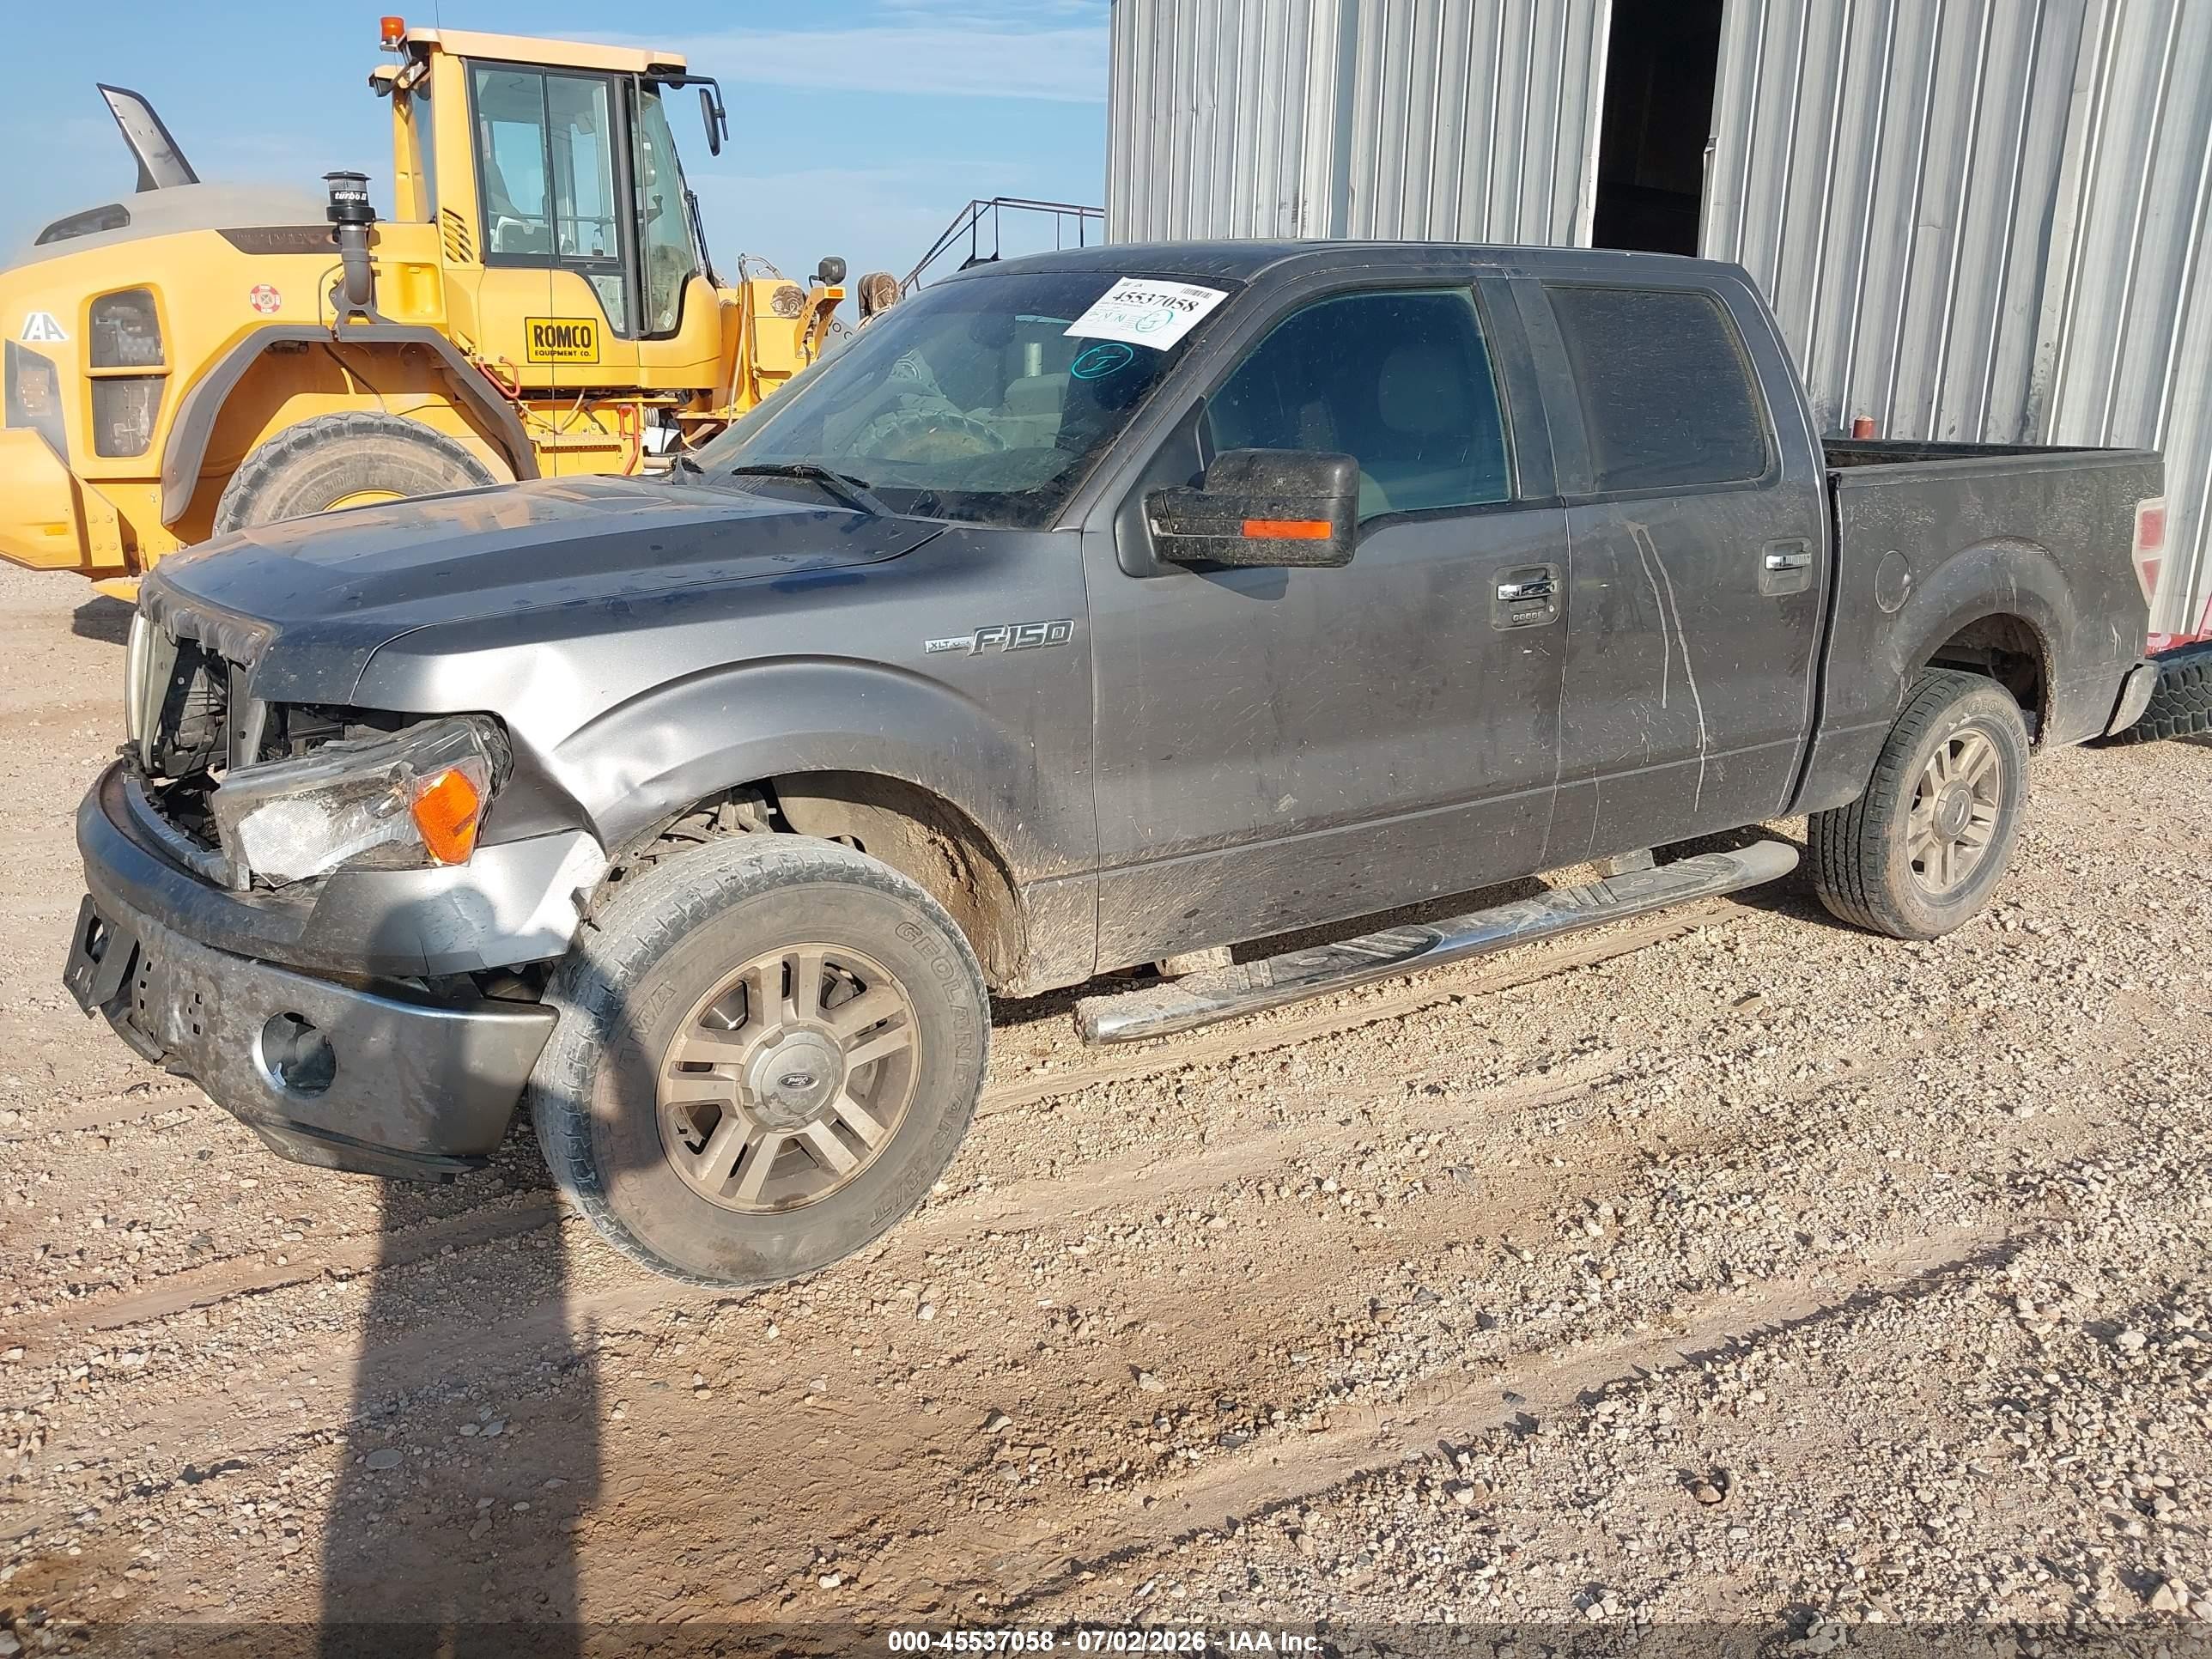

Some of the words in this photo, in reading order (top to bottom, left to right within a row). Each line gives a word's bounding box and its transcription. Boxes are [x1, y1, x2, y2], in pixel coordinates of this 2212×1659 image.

[1113, 291, 1200, 313] 45537058
[533, 325, 592, 348] ROMCO
[930, 640, 950, 651] XLT
[969, 618, 1074, 656] F-150
[895, 921, 973, 1151] GEOLANDAR
[786, 1077, 809, 1086] Ford
